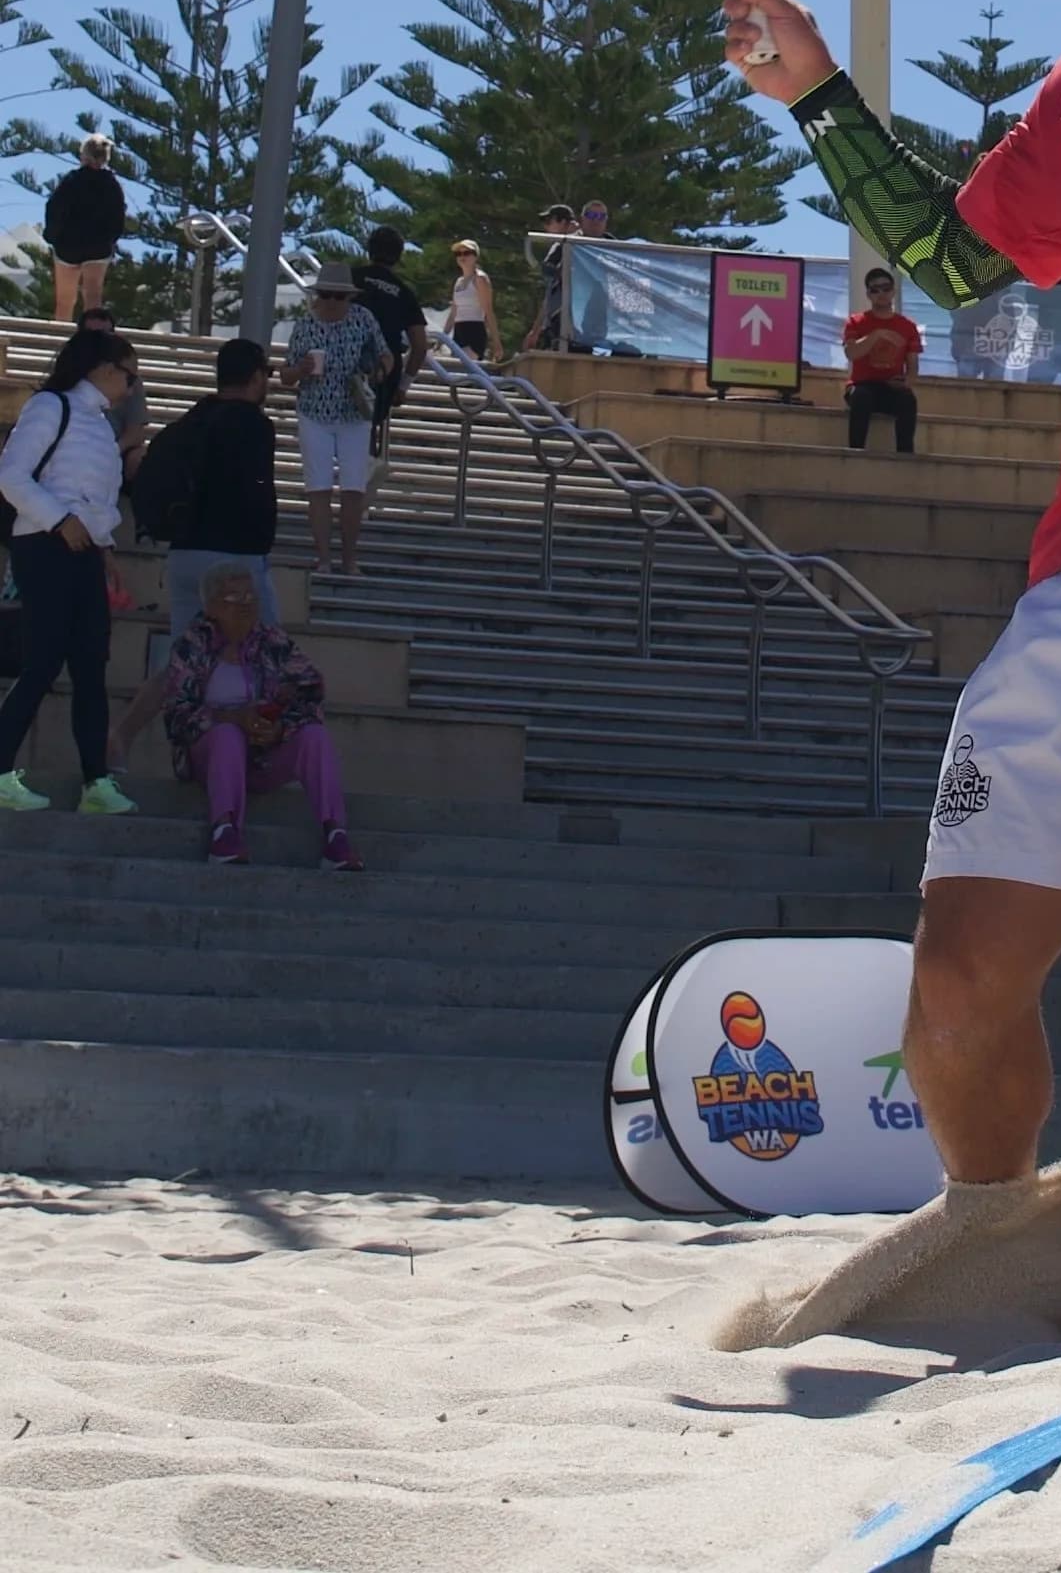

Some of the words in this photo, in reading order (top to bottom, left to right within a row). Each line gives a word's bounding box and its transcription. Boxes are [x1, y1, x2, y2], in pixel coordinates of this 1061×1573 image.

[735, 278, 781, 292] TOILETS
[693, 1071, 818, 1106] BEACH
[699, 1100, 821, 1136] TENNIS
[743, 1128, 788, 1152] WA
